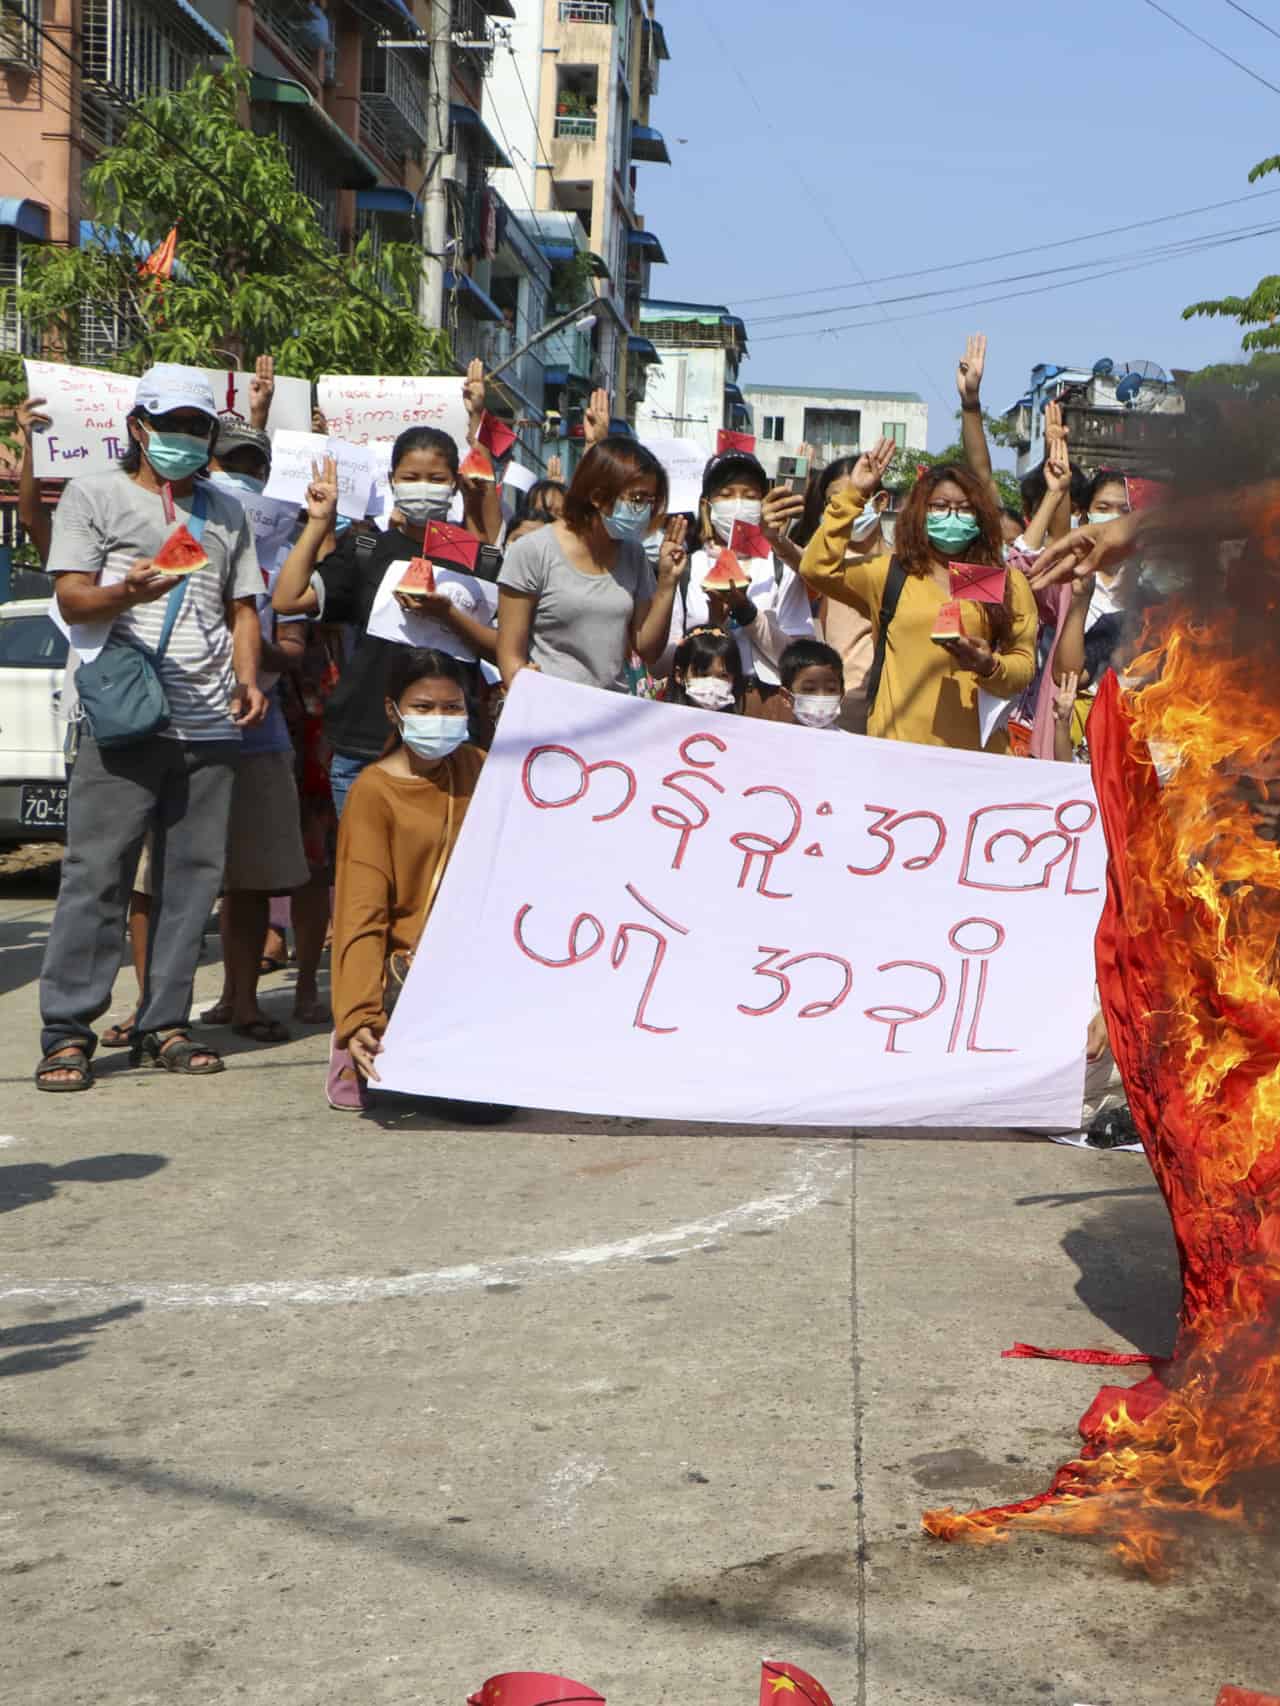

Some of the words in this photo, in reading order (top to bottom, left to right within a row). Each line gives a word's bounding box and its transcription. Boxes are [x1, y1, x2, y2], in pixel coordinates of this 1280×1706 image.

[84, 417, 114, 430] And
[48, 436, 88, 462] Fuck
[50, 788, 67, 799] YG
